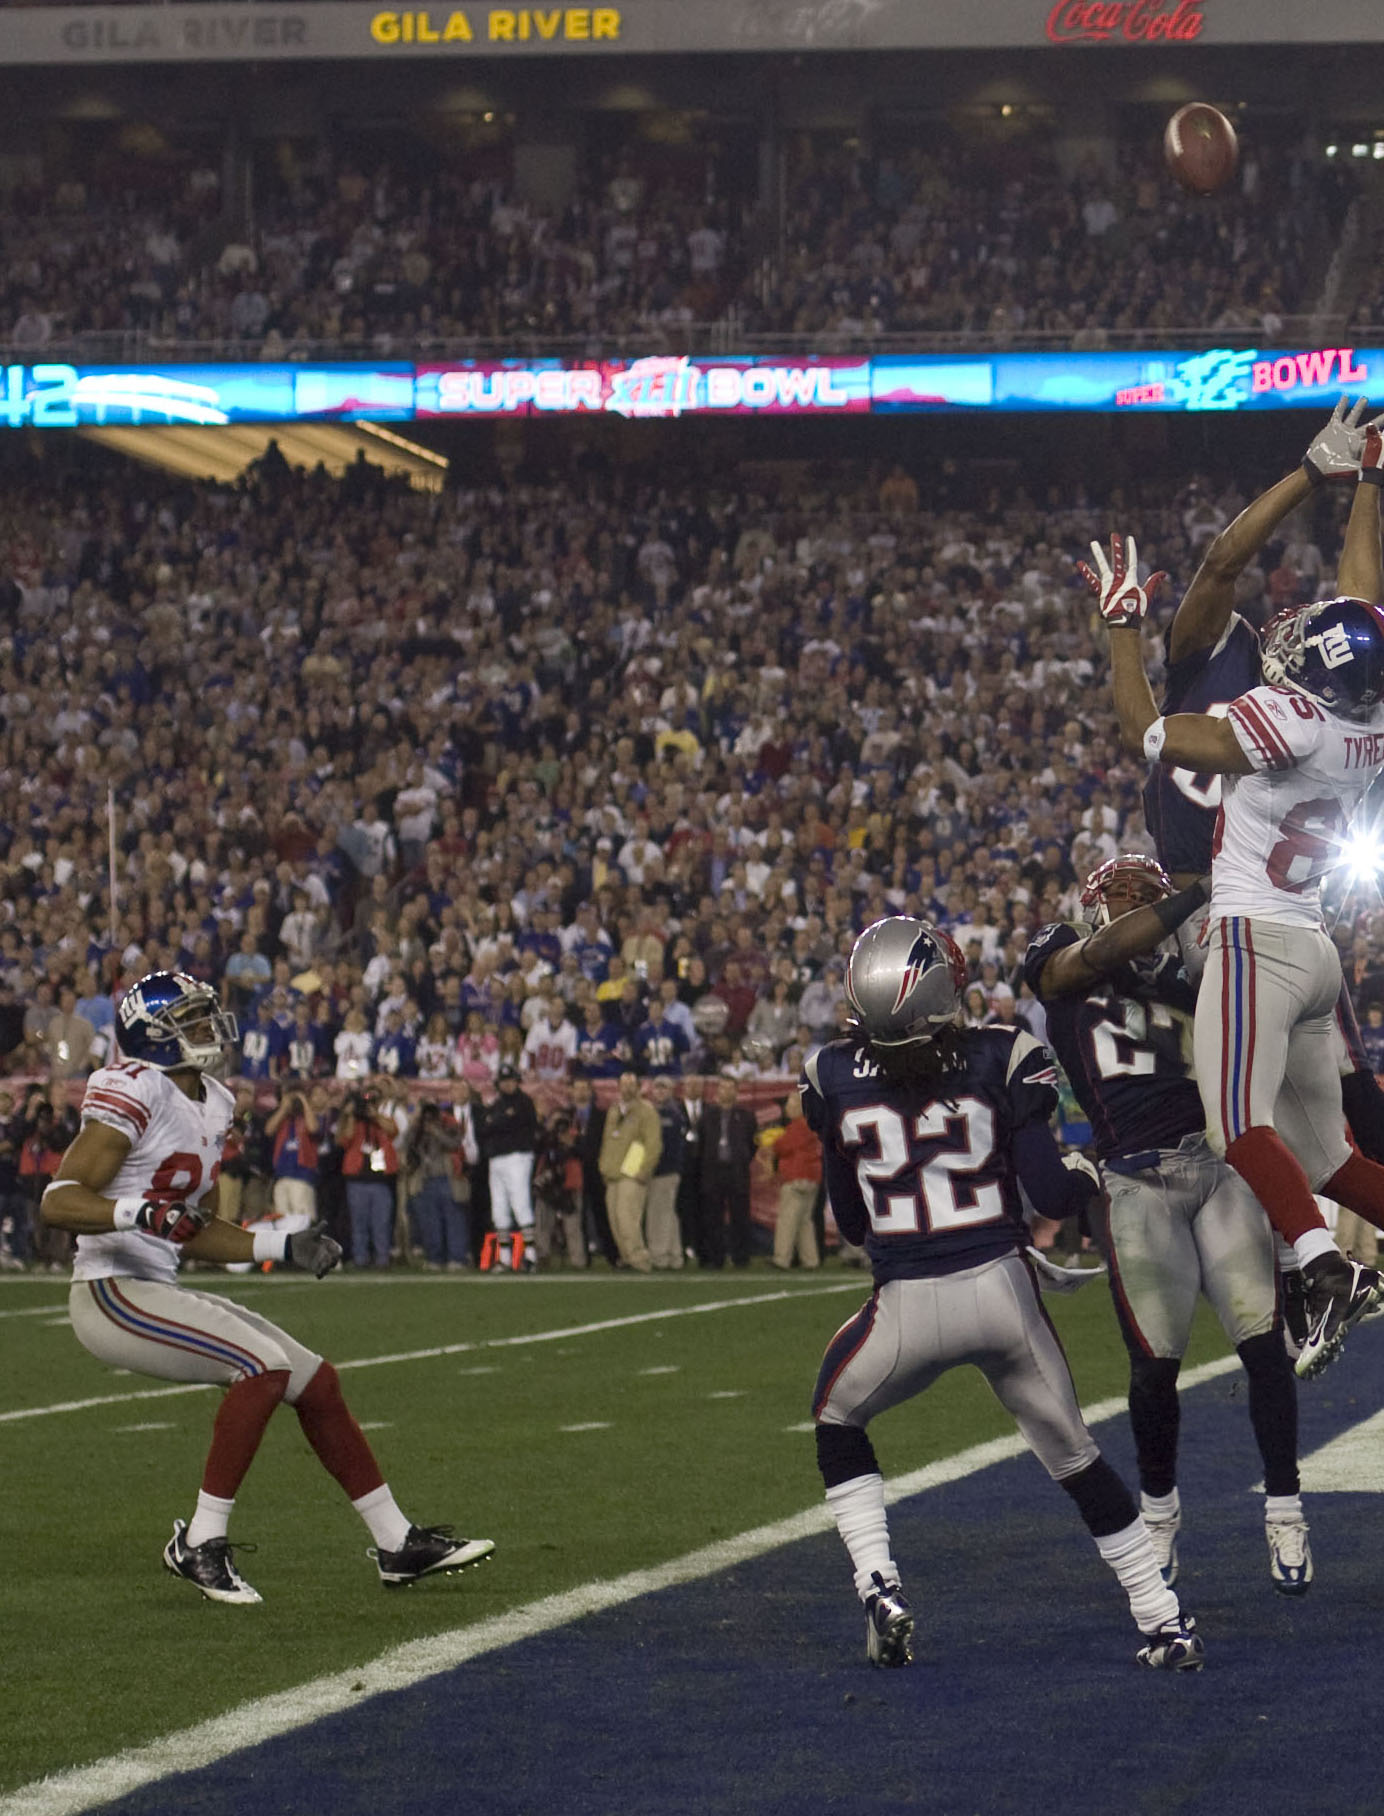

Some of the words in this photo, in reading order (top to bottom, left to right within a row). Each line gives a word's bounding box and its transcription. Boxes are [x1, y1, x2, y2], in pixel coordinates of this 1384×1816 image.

[370, 11, 473, 44] GILA
[488, 8, 622, 41] RIVER
[437, 370, 604, 412] SUPER
[706, 366, 849, 408] BOWL
[1252, 348, 1368, 394] BOWL
[840, 1095, 1004, 1234] 22
